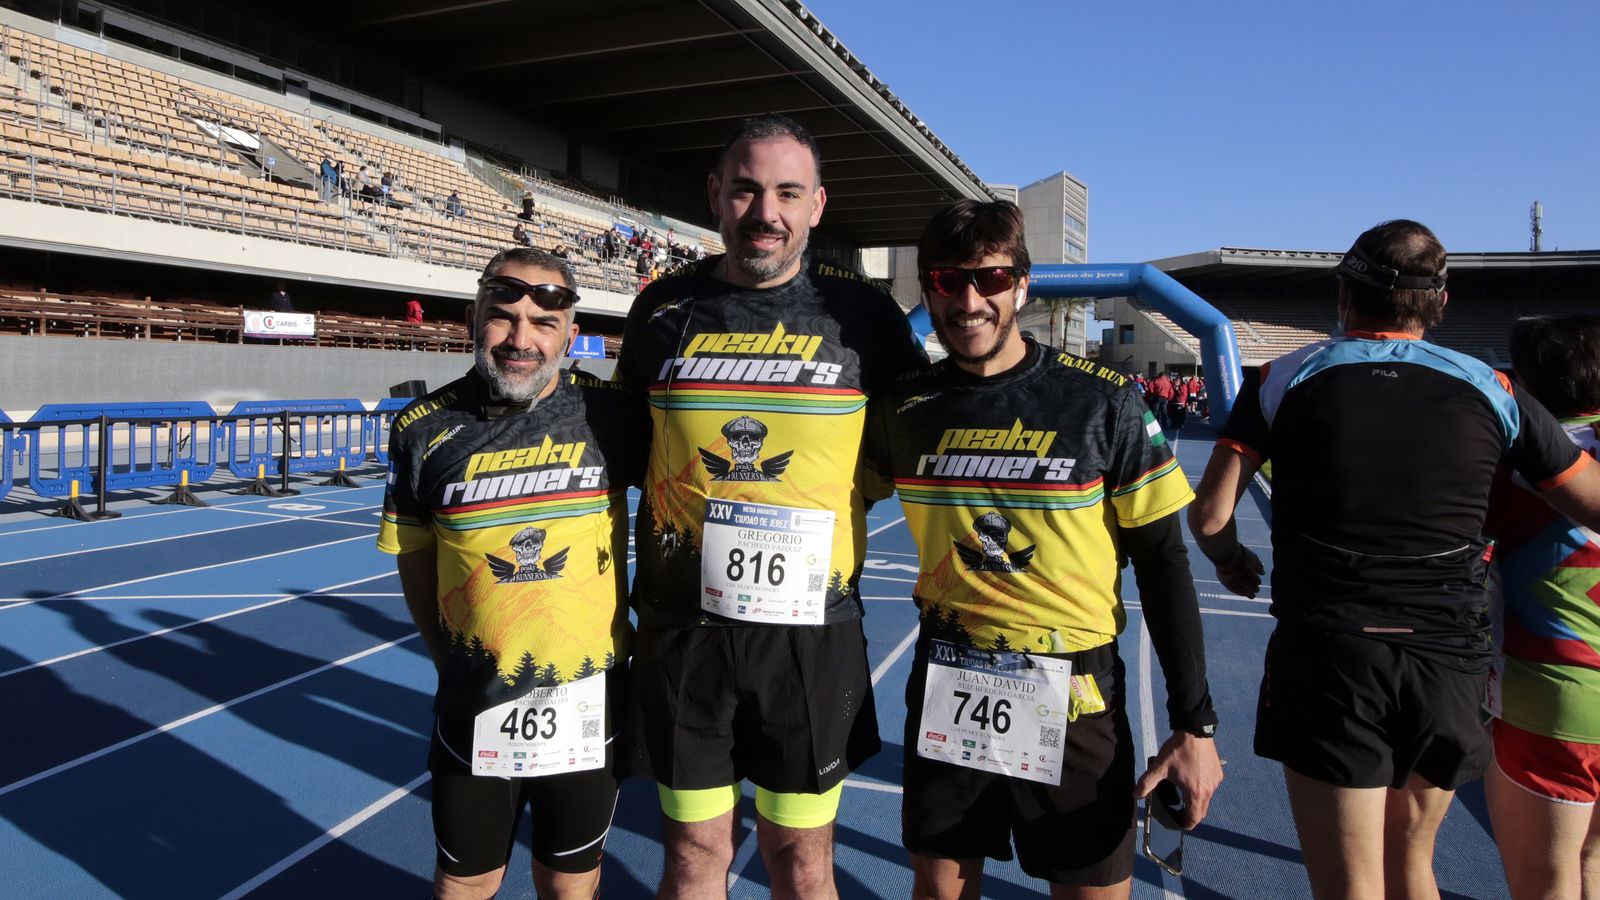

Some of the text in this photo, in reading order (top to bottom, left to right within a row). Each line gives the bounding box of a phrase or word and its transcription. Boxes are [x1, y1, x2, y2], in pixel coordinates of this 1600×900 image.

[683, 320, 823, 362] peaky
[657, 356, 842, 385] runners
[1057, 352, 1128, 387] TRAIL RUN
[395, 389, 459, 433] TRAIL RUN
[936, 417, 1057, 458] peaky
[464, 434, 586, 482] peaky
[916, 454, 1076, 481] runners
[441, 466, 604, 506] runners
[709, 502, 734, 520] XXV
[759, 517, 768, 527] DE
[737, 541, 802, 553] PACHECO VAZQUEZ
[738, 529, 802, 545] GREGORIO
[726, 548, 786, 587] 816
[525, 687, 568, 698] OBERTO
[957, 671, 1036, 693] JUAN DAVID
[500, 707, 557, 741] 463
[953, 690, 1012, 734] 746
